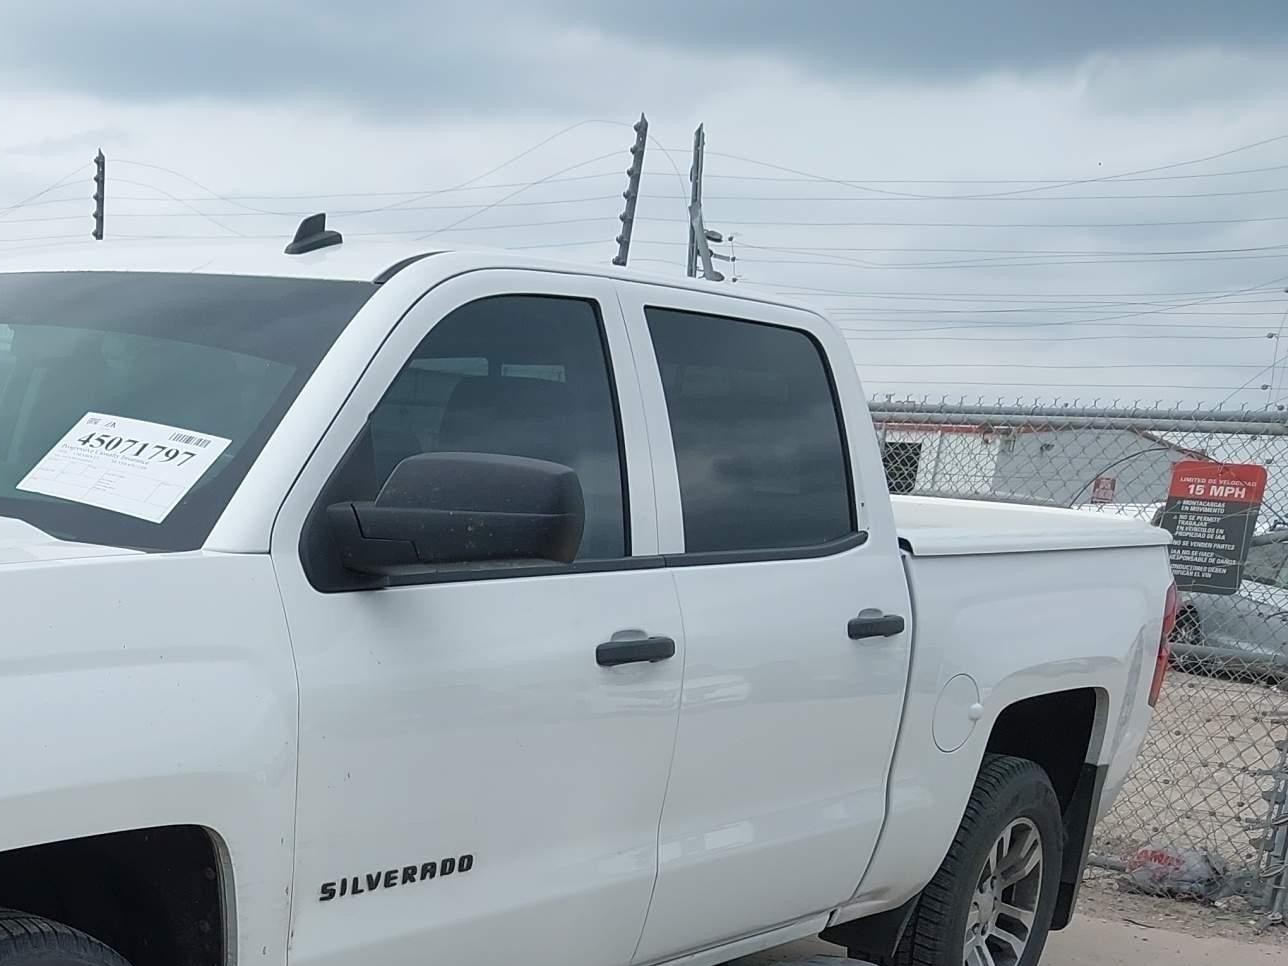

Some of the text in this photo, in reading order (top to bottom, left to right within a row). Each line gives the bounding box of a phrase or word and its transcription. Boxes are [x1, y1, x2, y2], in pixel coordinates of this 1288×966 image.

[76, 431, 198, 467] 45071797
[1188, 484, 1246, 499] 15 MPH
[319, 854, 474, 902] SILVERADO
